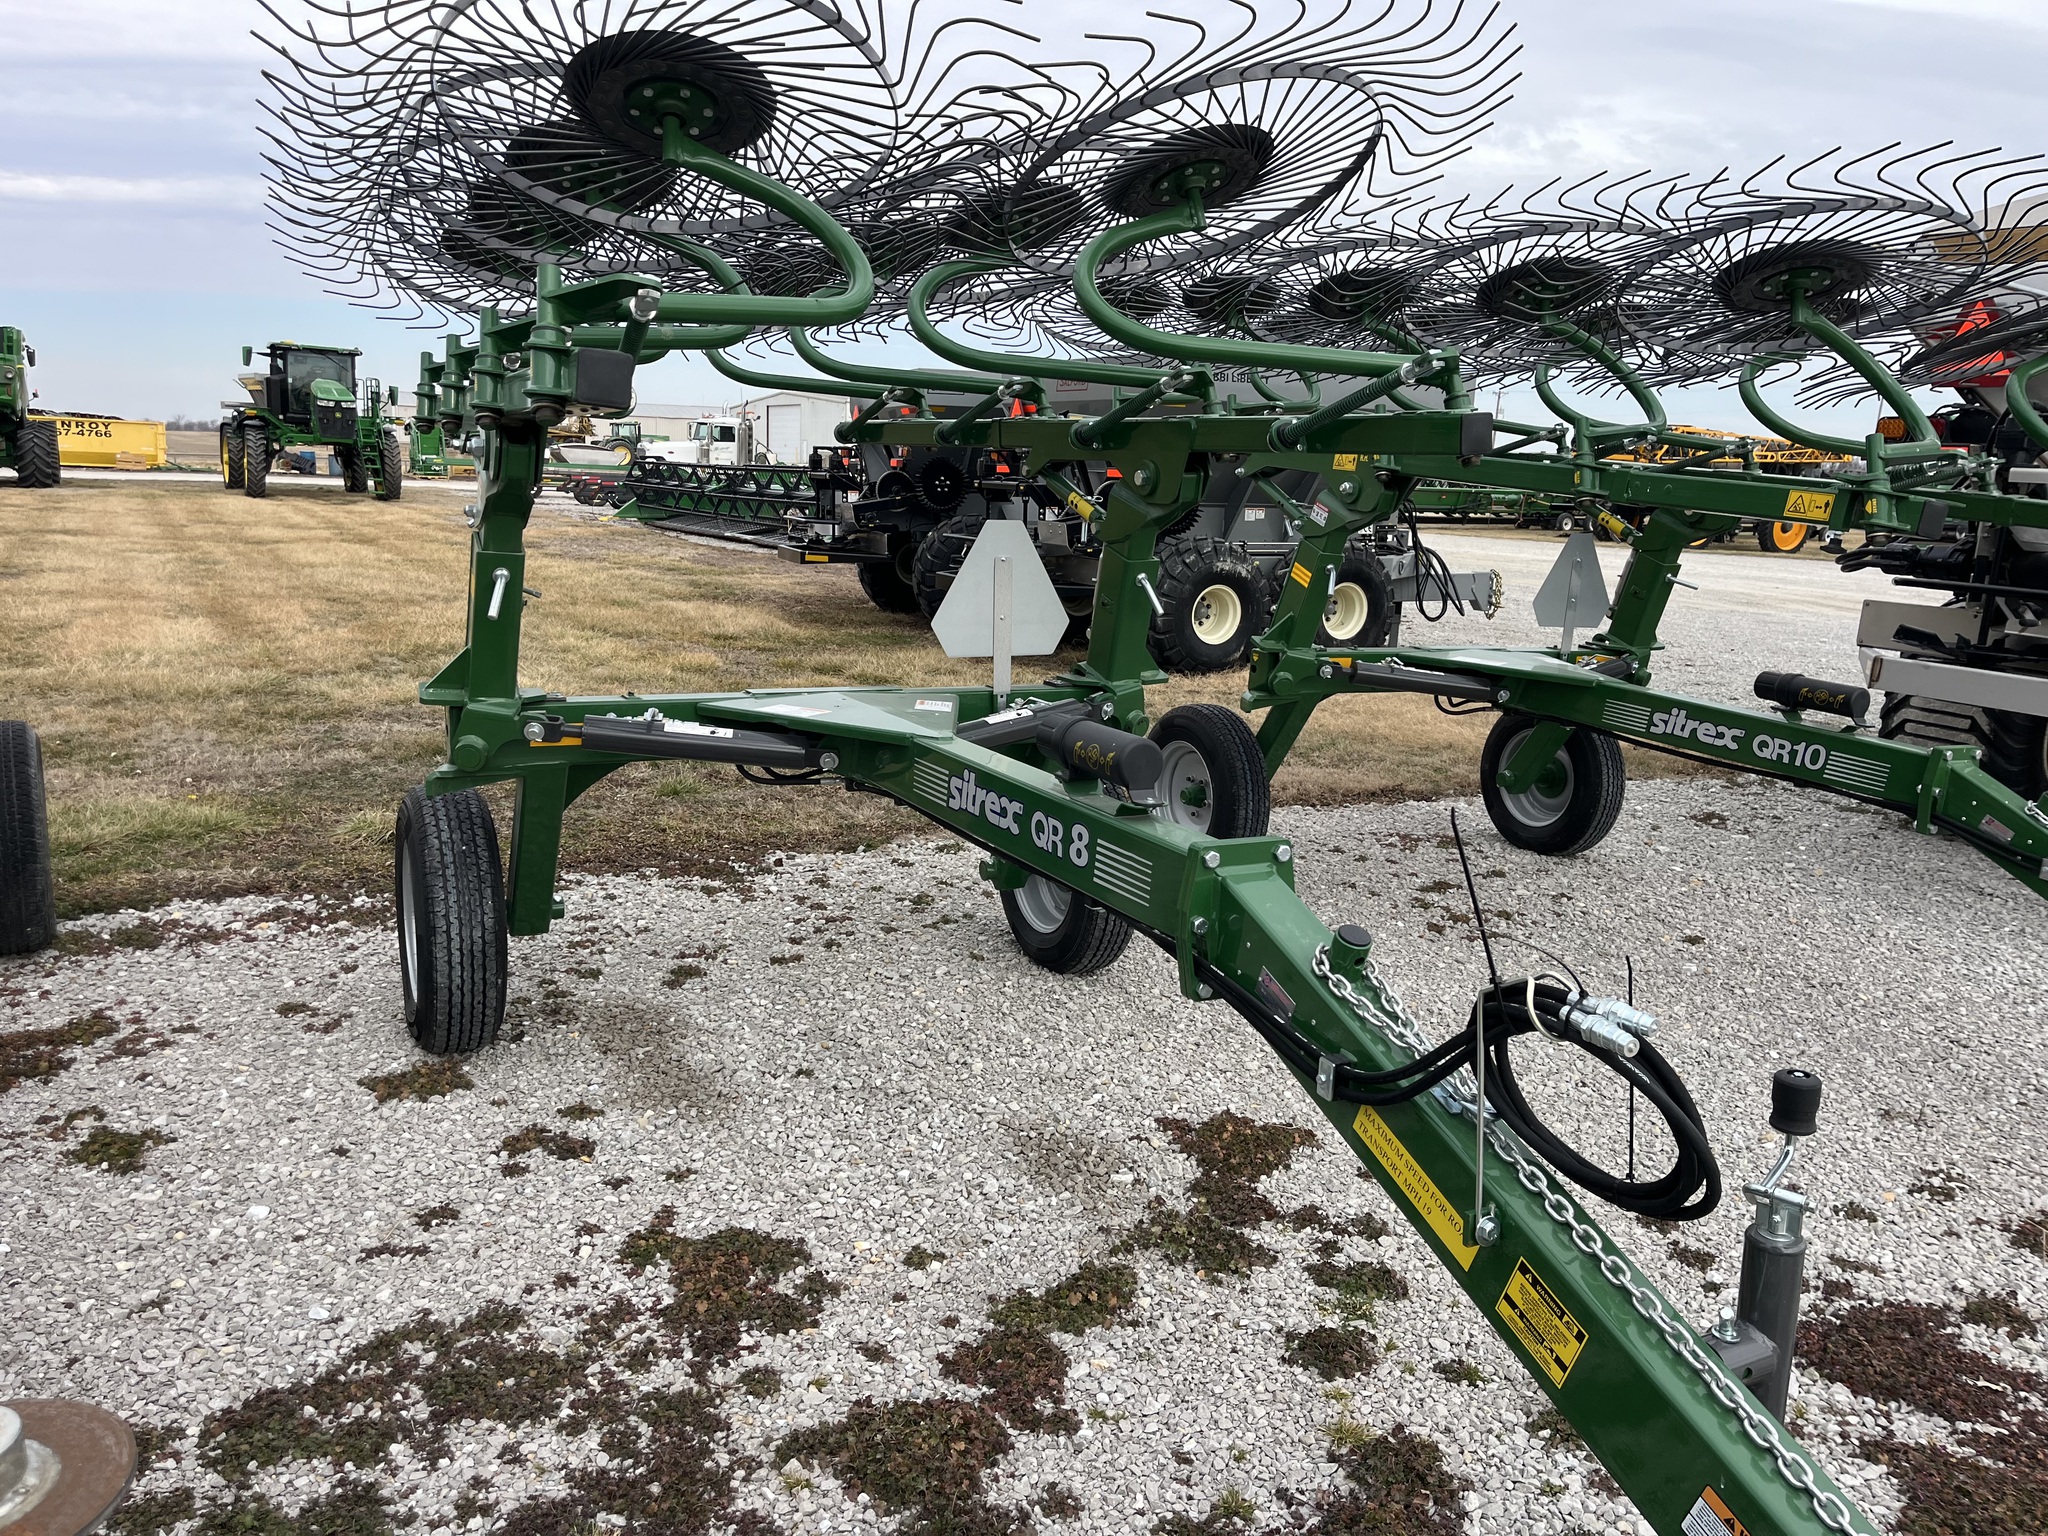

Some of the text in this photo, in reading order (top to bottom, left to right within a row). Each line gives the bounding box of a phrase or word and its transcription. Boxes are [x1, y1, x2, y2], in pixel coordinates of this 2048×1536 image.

[1649, 707, 1746, 750] sitrex
[948, 768, 1089, 867] sitrex QR 8
[1359, 1119, 1432, 1215] TRANSPORT MPH 19
[1363, 1108, 1404, 1161] MAXIMUM
[1403, 1159, 1430, 1193] SPEED
[1430, 1191, 1448, 1217] FOR
[1522, 1317, 1543, 1343] WARNING
[1535, 1284, 1561, 1316] WARNING
